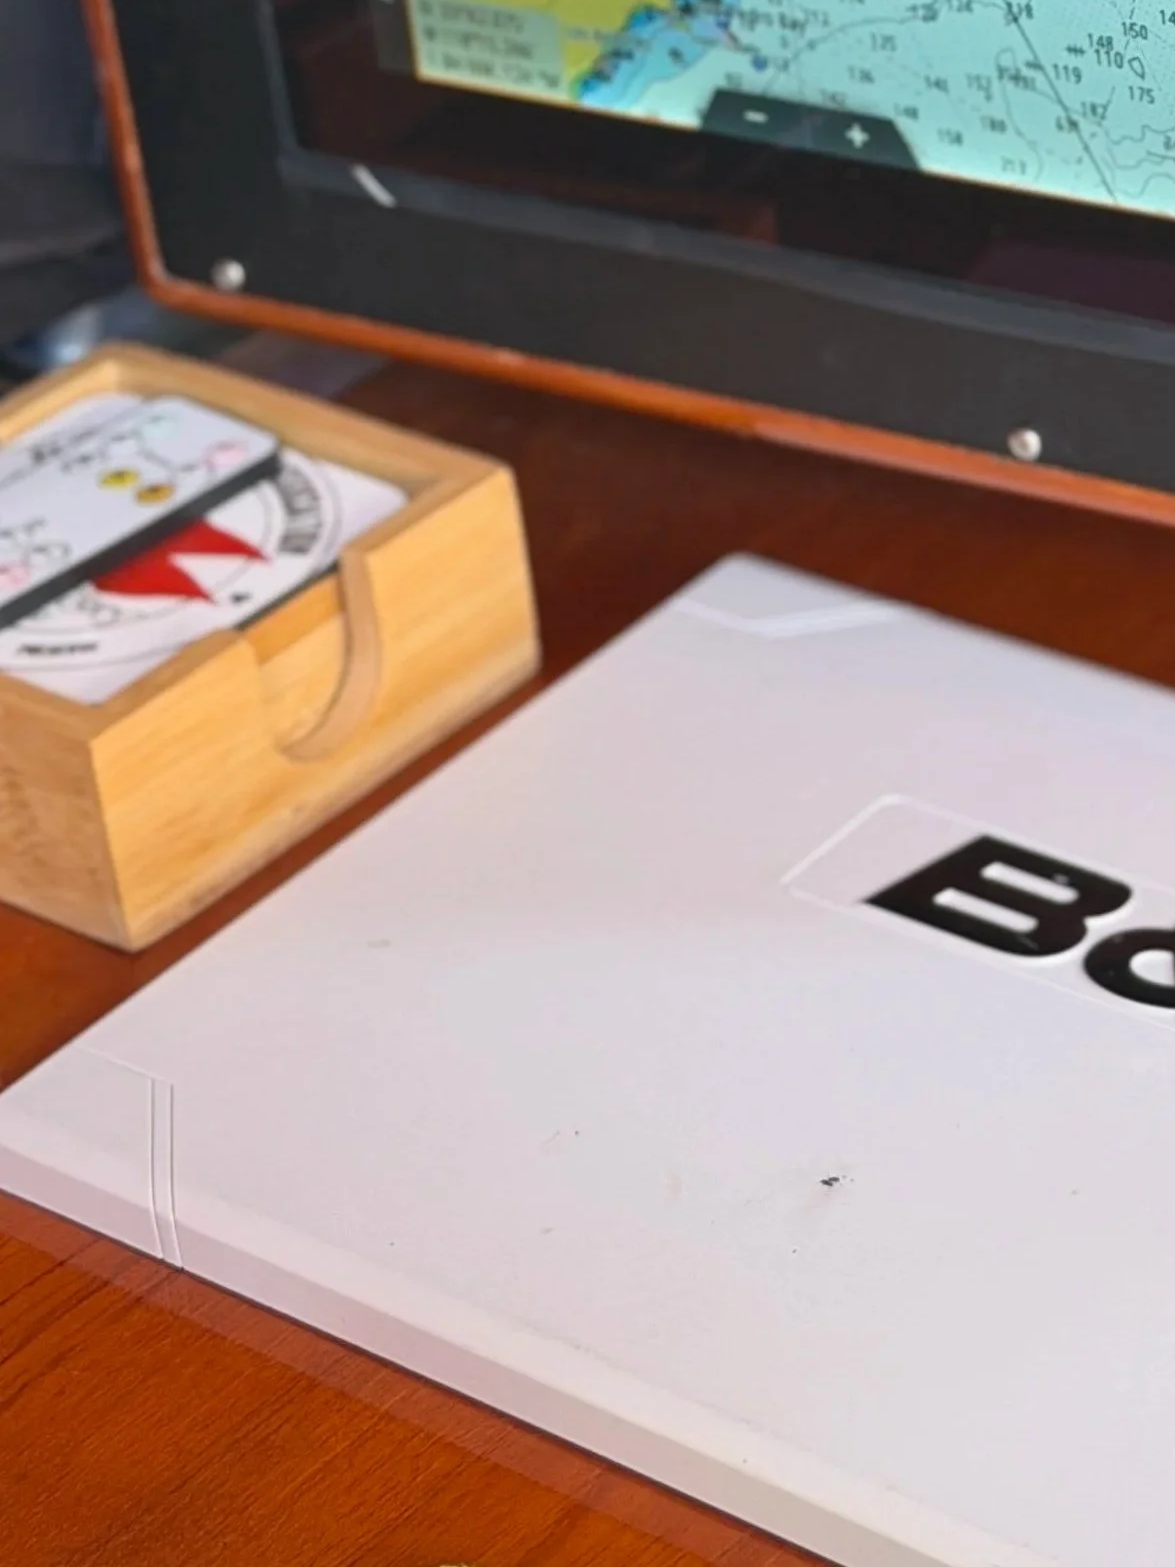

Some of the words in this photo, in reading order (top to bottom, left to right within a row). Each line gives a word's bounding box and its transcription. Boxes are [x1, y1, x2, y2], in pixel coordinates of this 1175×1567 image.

[1121, 21, 1149, 40] 150
[1087, 33, 1115, 51] 148
[1094, 48, 1125, 69] 110
[1052, 63, 1082, 84] 119
[1128, 85, 1155, 105] 175
